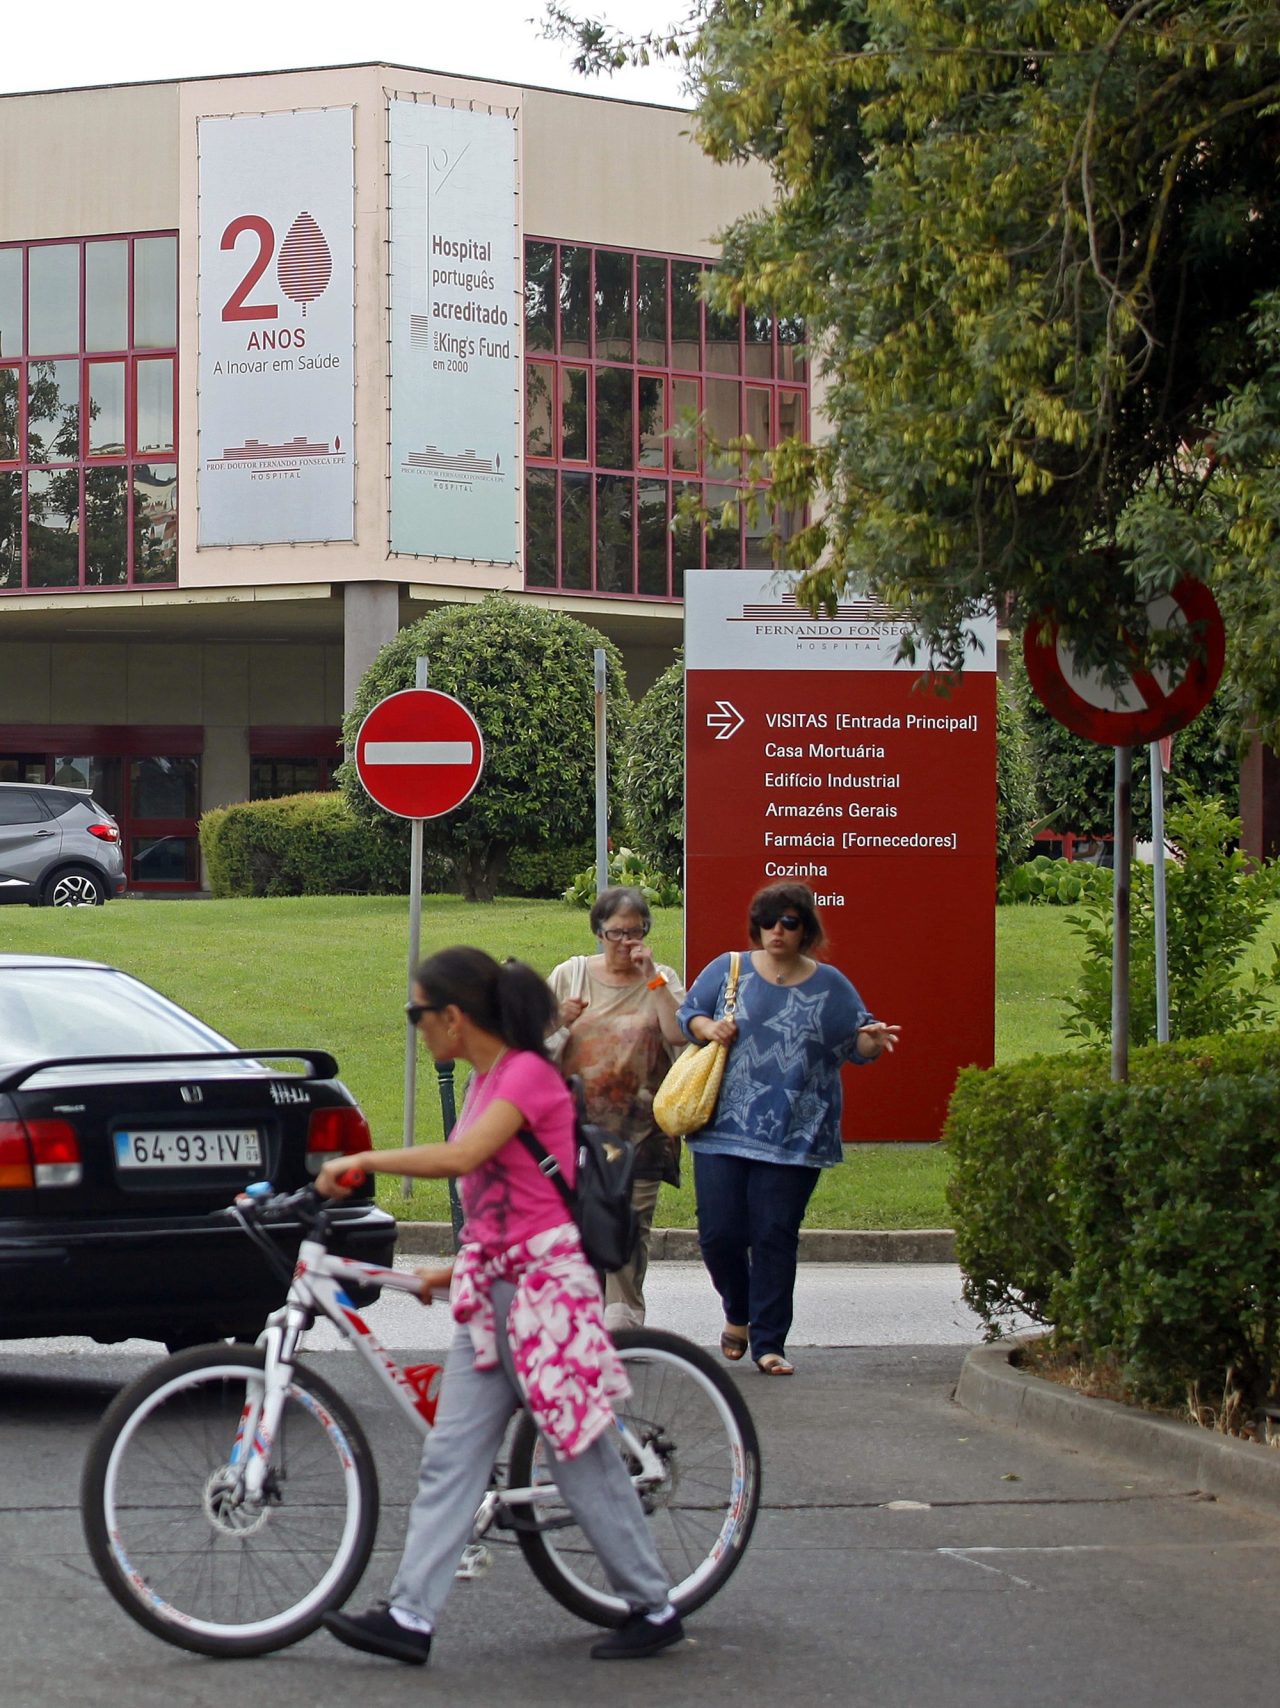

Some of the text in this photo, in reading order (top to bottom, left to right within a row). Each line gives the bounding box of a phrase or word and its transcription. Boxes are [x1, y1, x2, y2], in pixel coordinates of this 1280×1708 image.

[432, 234, 491, 262] Hospital
[432, 269, 494, 292] português
[432, 301, 508, 326] acreditado
[247, 328, 305, 350] ANOS
[439, 332, 510, 359] King's Fund
[213, 353, 339, 374] A Inovar em Saúde
[432, 360, 468, 373] em 2000
[206, 463, 225, 471] PROF.
[227, 462, 256, 470] DOUTOR
[260, 460, 296, 469] FERNANDO
[300, 458, 330, 466] FONSECA
[251, 472, 300, 480] HOSPITAL
[433, 483, 473, 492] HOSPITAL
[755, 625, 919, 636] FERNANDO FONSECA
[765, 713, 978, 732] VISITAS [Entrada Principal]
[765, 742, 885, 758] Casa Mortuária
[765, 772, 900, 788] Edifício Industrial
[765, 802, 898, 817] Armazéns Gerais
[764, 832, 957, 849] Farmácia [Fornecedores]
[765, 862, 828, 876] Cozinha
